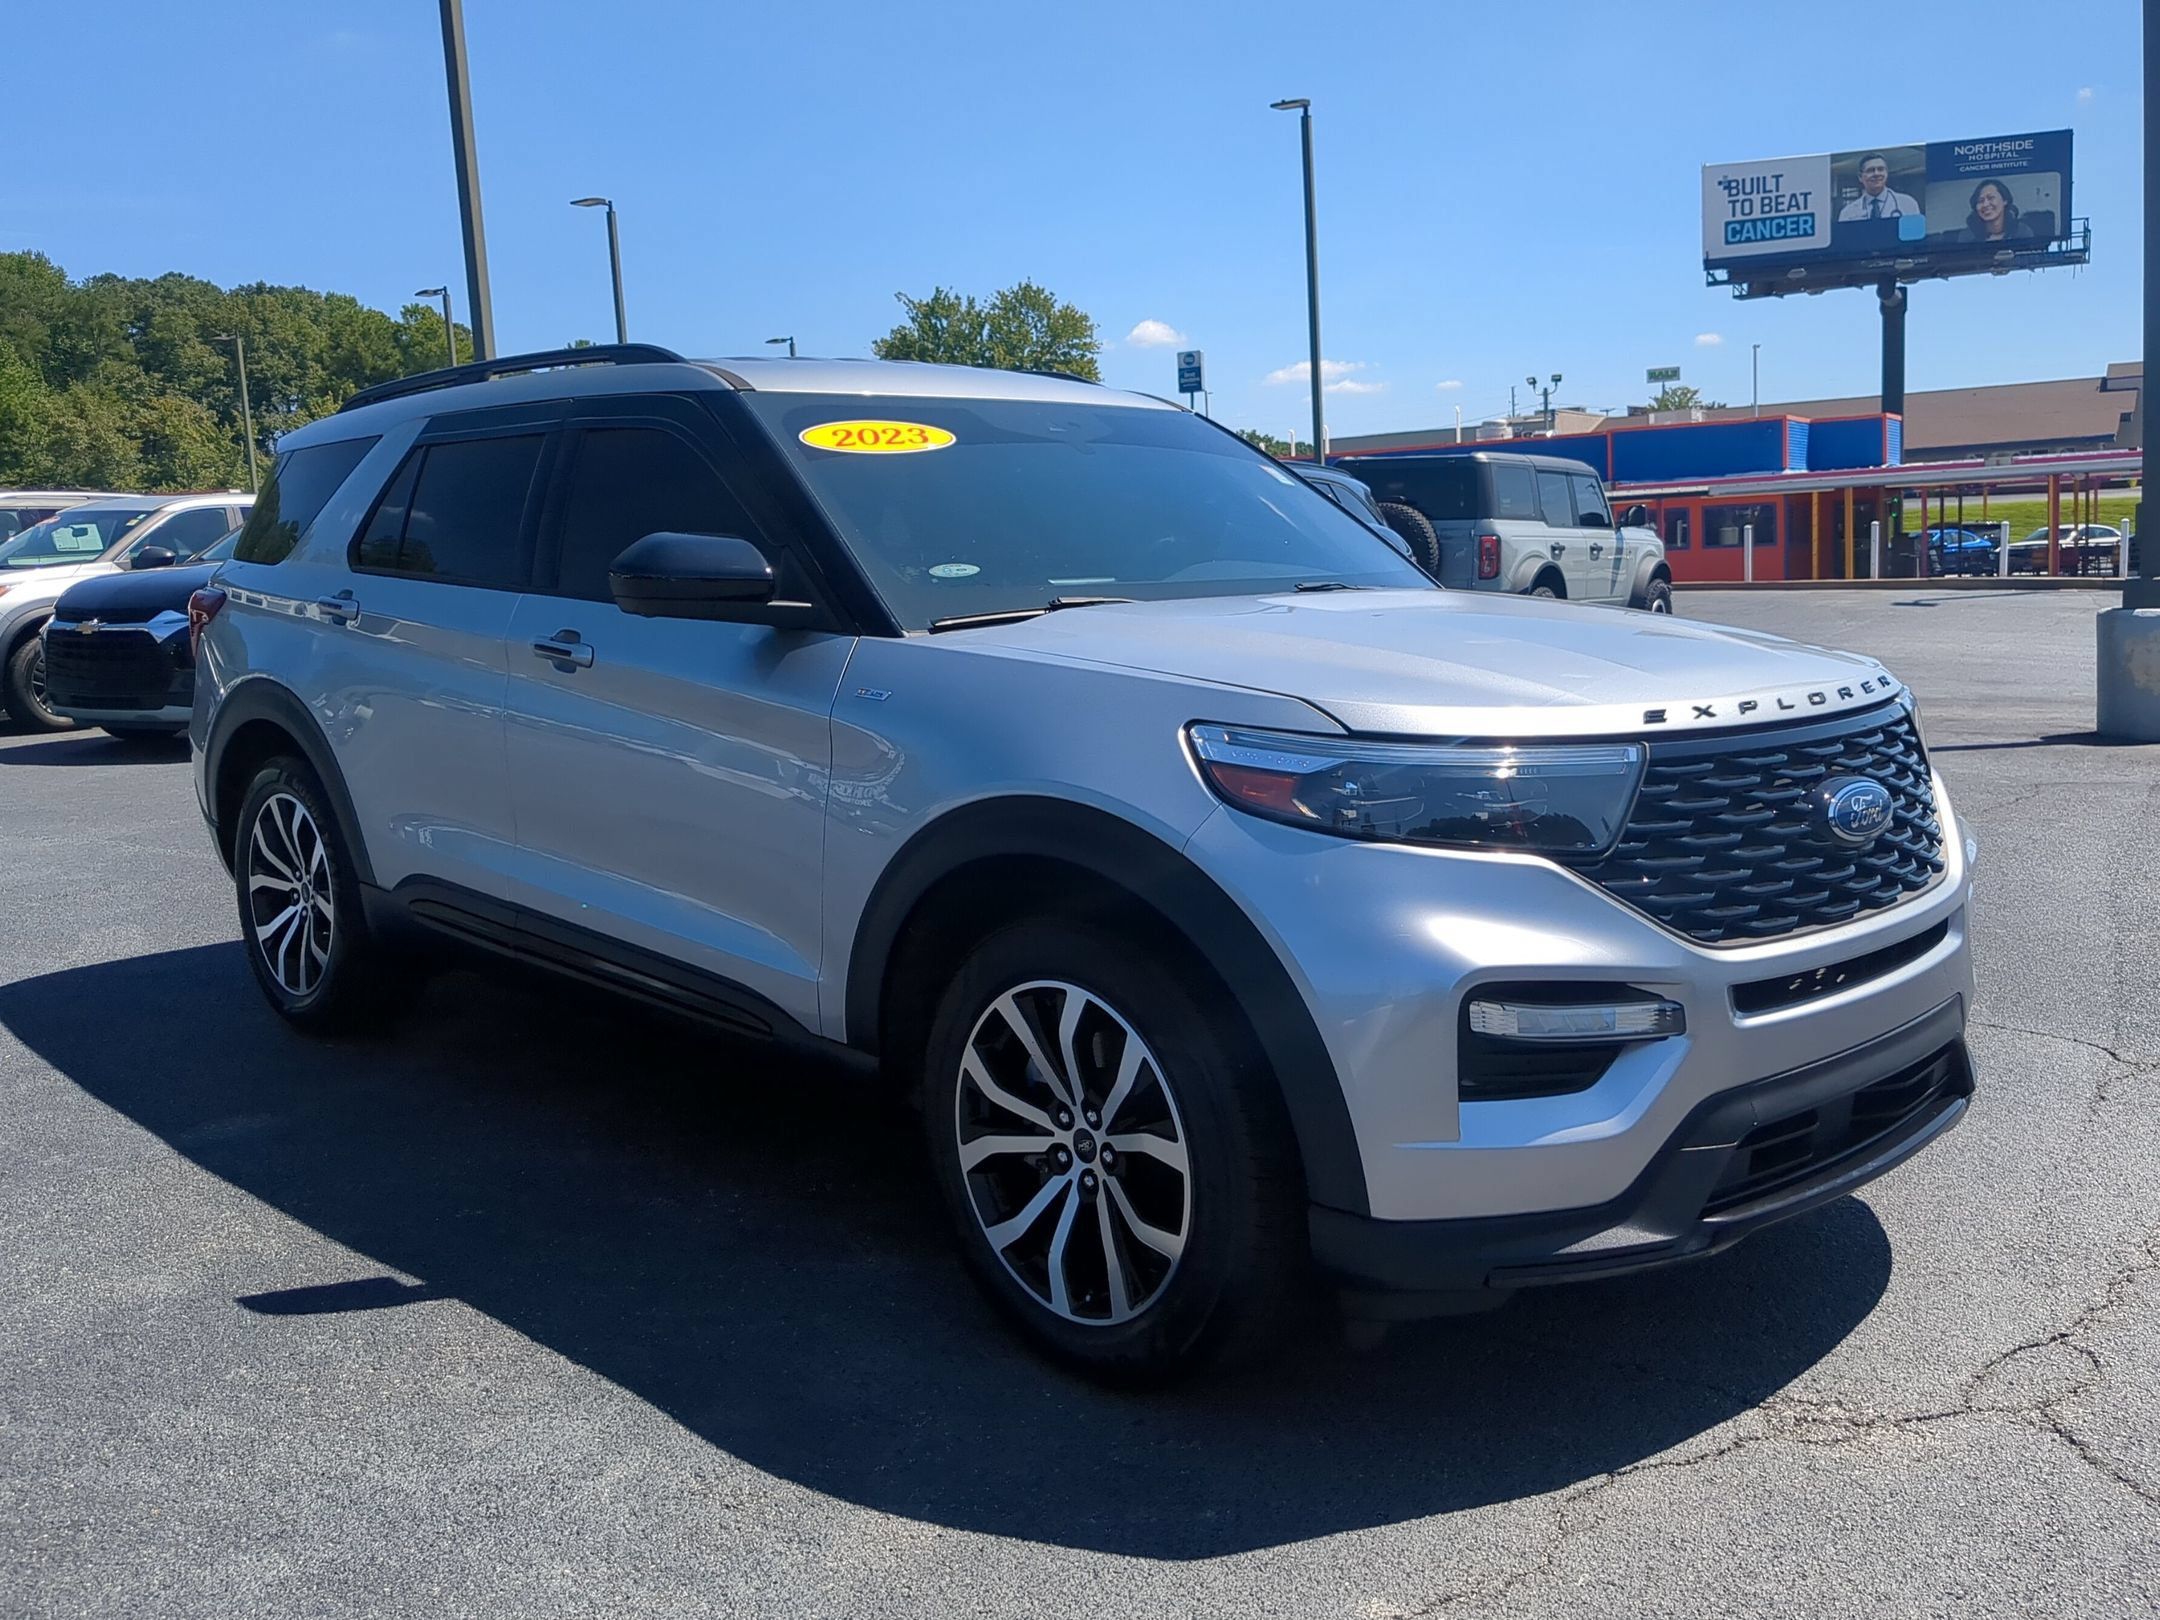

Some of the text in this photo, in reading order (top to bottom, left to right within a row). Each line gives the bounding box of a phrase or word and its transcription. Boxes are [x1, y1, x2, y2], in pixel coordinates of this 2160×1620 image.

[1954, 140, 2034, 156] NORTHSIDE
[1968, 151, 2019, 161] HOSPITAL
[1960, 161, 2028, 172] CANCER INSTITUTE
[1727, 174, 1784, 198] BUILT
[1727, 192, 1812, 218] TO BEAT
[1727, 215, 1814, 243] CANCER
[832, 427, 929, 447] 2023
[1643, 675, 1891, 724] EXPLORER
[1850, 794, 1883, 828] Ford
